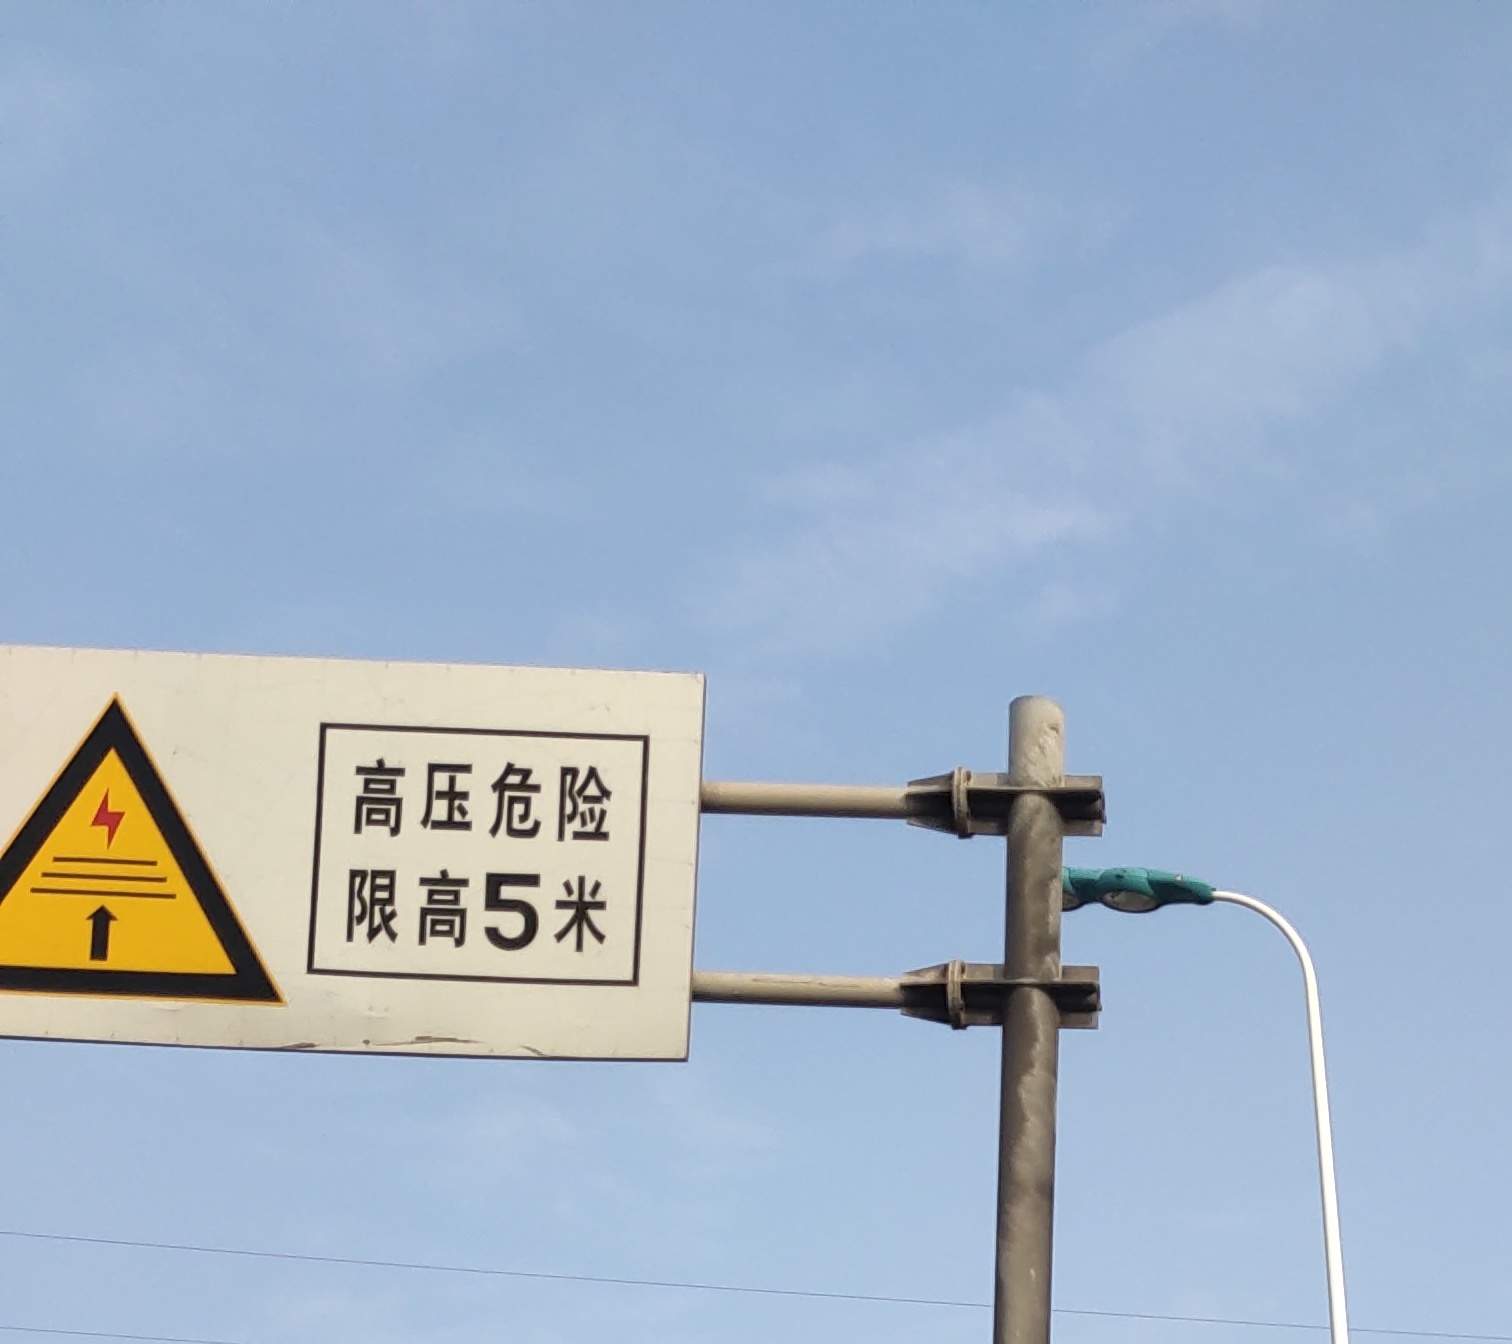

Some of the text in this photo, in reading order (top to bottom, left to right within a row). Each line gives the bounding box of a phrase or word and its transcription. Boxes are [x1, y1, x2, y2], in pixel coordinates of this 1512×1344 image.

[353, 757, 613, 842] 高压危险
[345, 867, 608, 953] 限高5米
